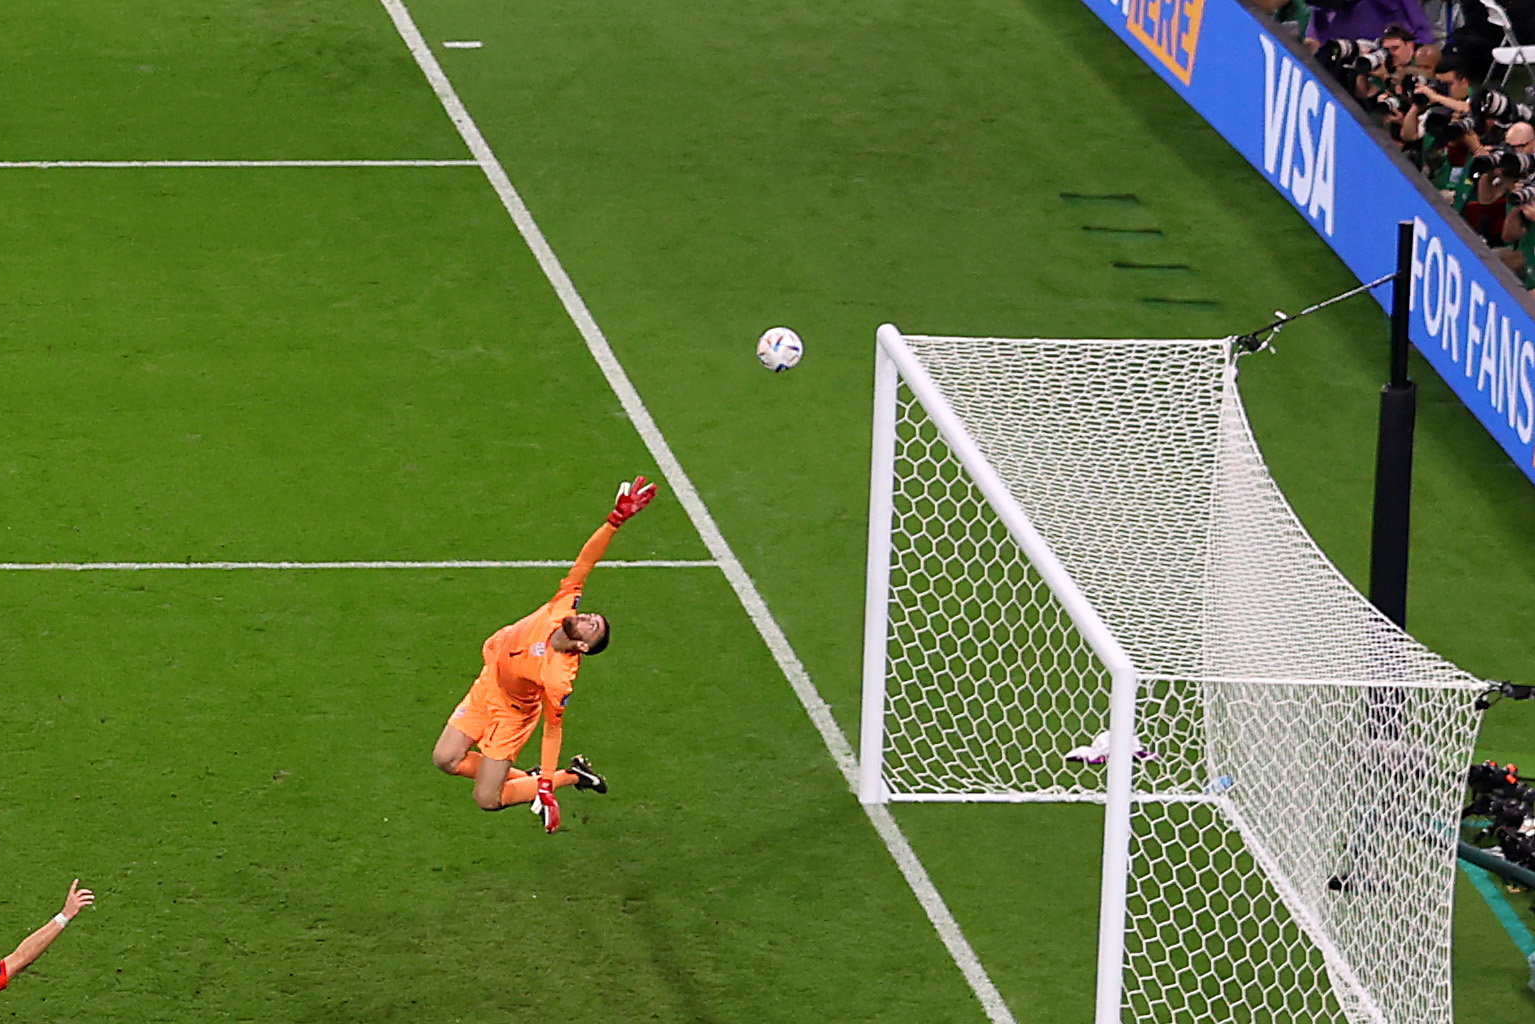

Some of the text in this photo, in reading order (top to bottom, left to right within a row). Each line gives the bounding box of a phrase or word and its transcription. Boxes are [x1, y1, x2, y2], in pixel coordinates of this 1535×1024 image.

[1259, 33, 1337, 237] VISA
[1409, 215, 1535, 445] FOR FANS
